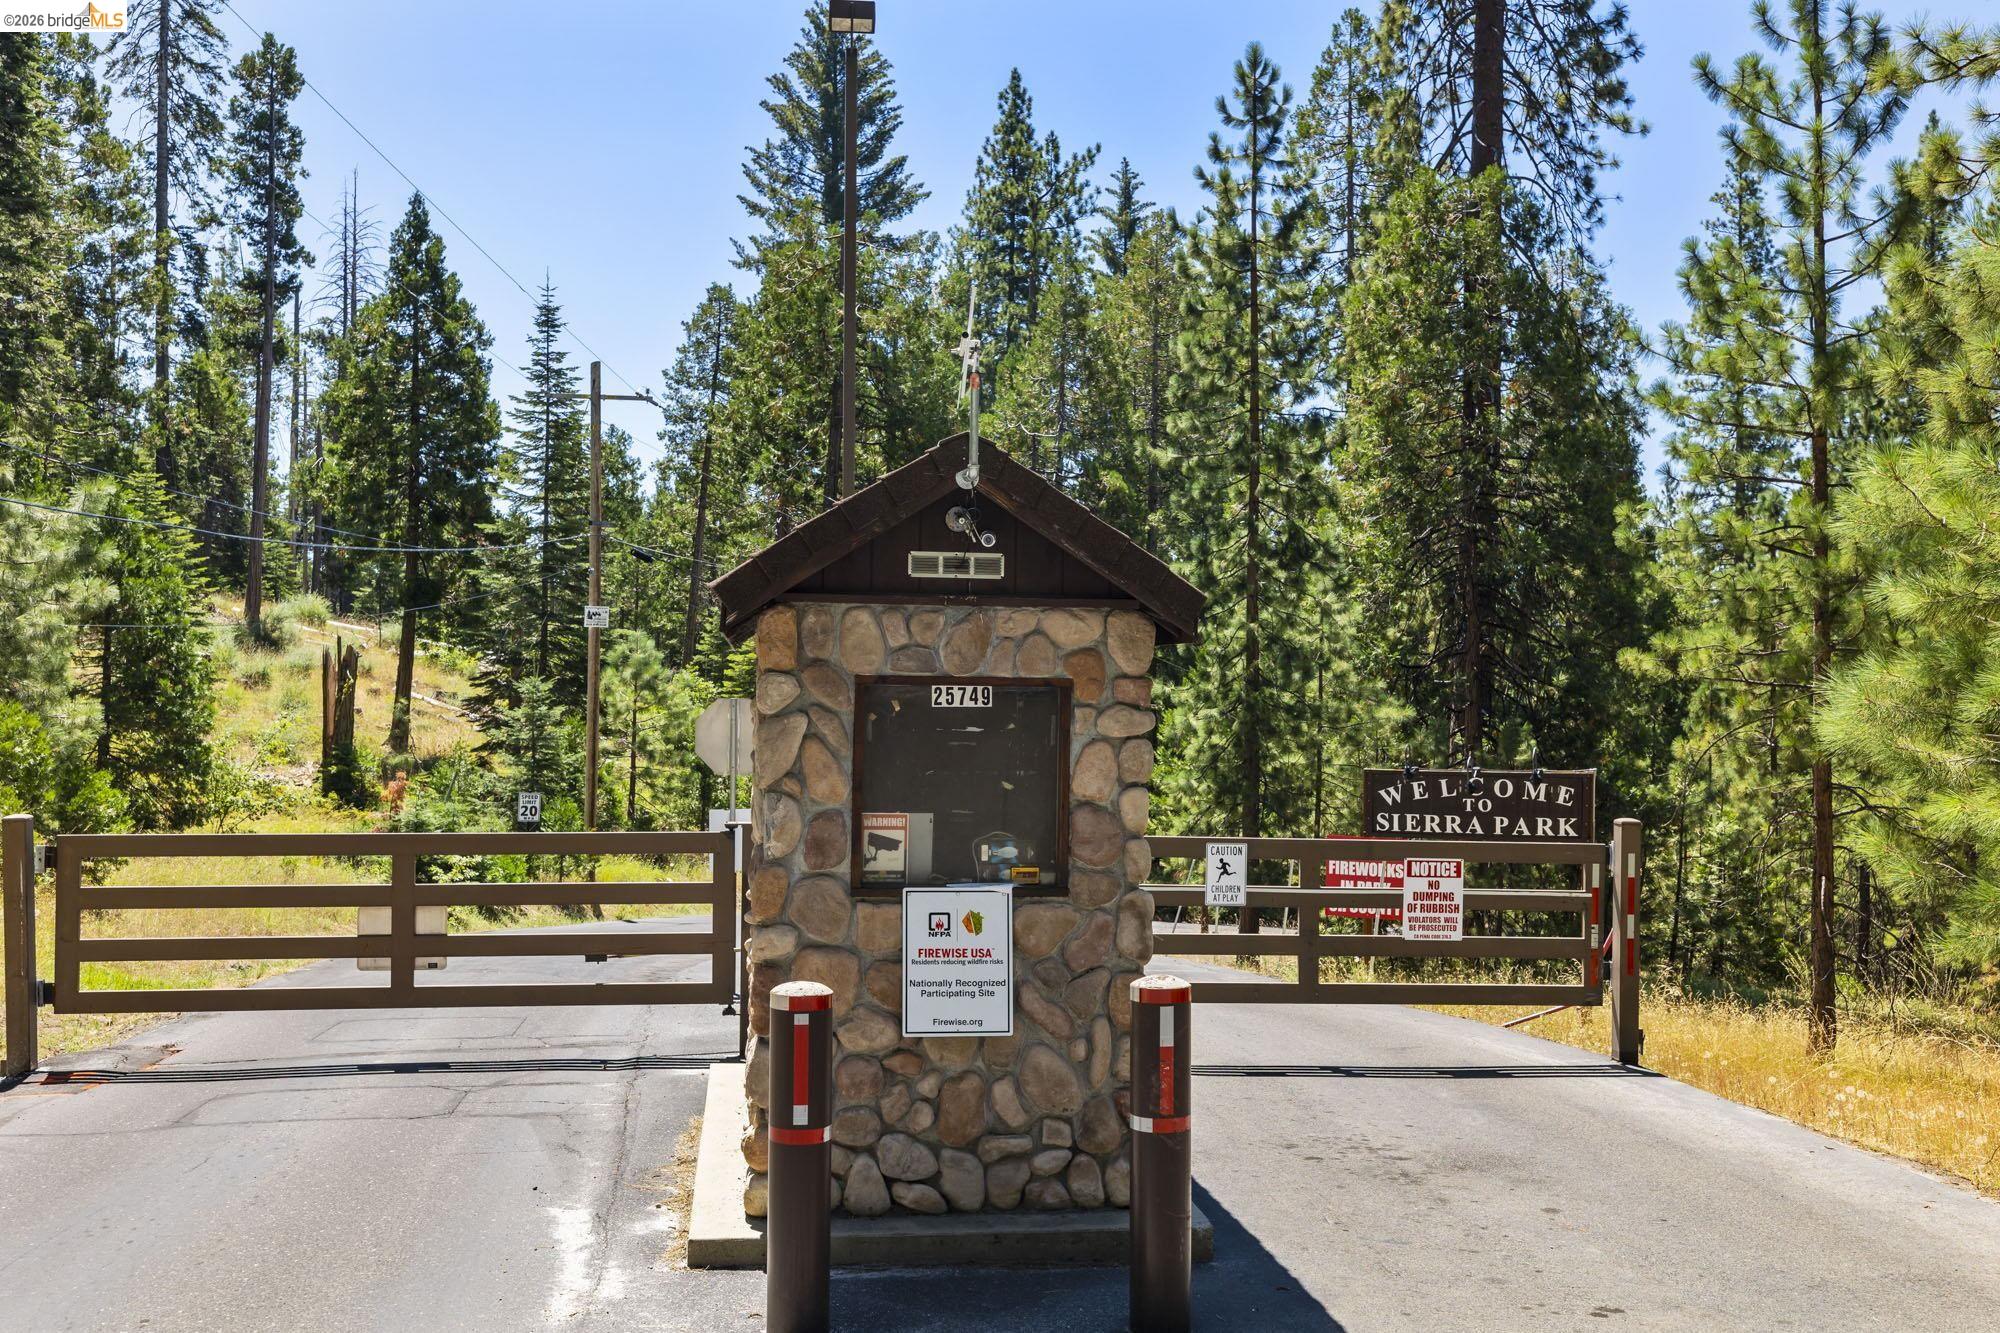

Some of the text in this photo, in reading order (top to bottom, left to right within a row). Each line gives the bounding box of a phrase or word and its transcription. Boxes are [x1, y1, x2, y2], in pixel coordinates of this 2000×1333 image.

[933, 686, 991, 706] 25749
[1378, 777, 1575, 807] WELCOME
[1463, 798, 1492, 812] TO
[520, 806, 537, 816] 20
[863, 817, 906, 827] WARNING!
[1376, 812, 1579, 837] SIERRA PARK
[1210, 846, 1243, 856] CAUTION
[1412, 862, 1456, 876] NOTICE
[1210, 885, 1241, 894] CHILDREN
[1428, 880, 1440, 890] NO
[1212, 894, 1239, 903] AT PLAY
[1413, 892, 1454, 902] DUMPING
[1407, 903, 1418, 913] OF
[1420, 903, 1460, 914] RUBBISH
[918, 948, 968, 959] FIREWISE
[940, 959, 966, 967] reducing
[909, 979, 1006, 989] Nationally Recognized
[920, 989, 995, 999] Participating Site
[932, 1018, 983, 1028] Firewise.org
